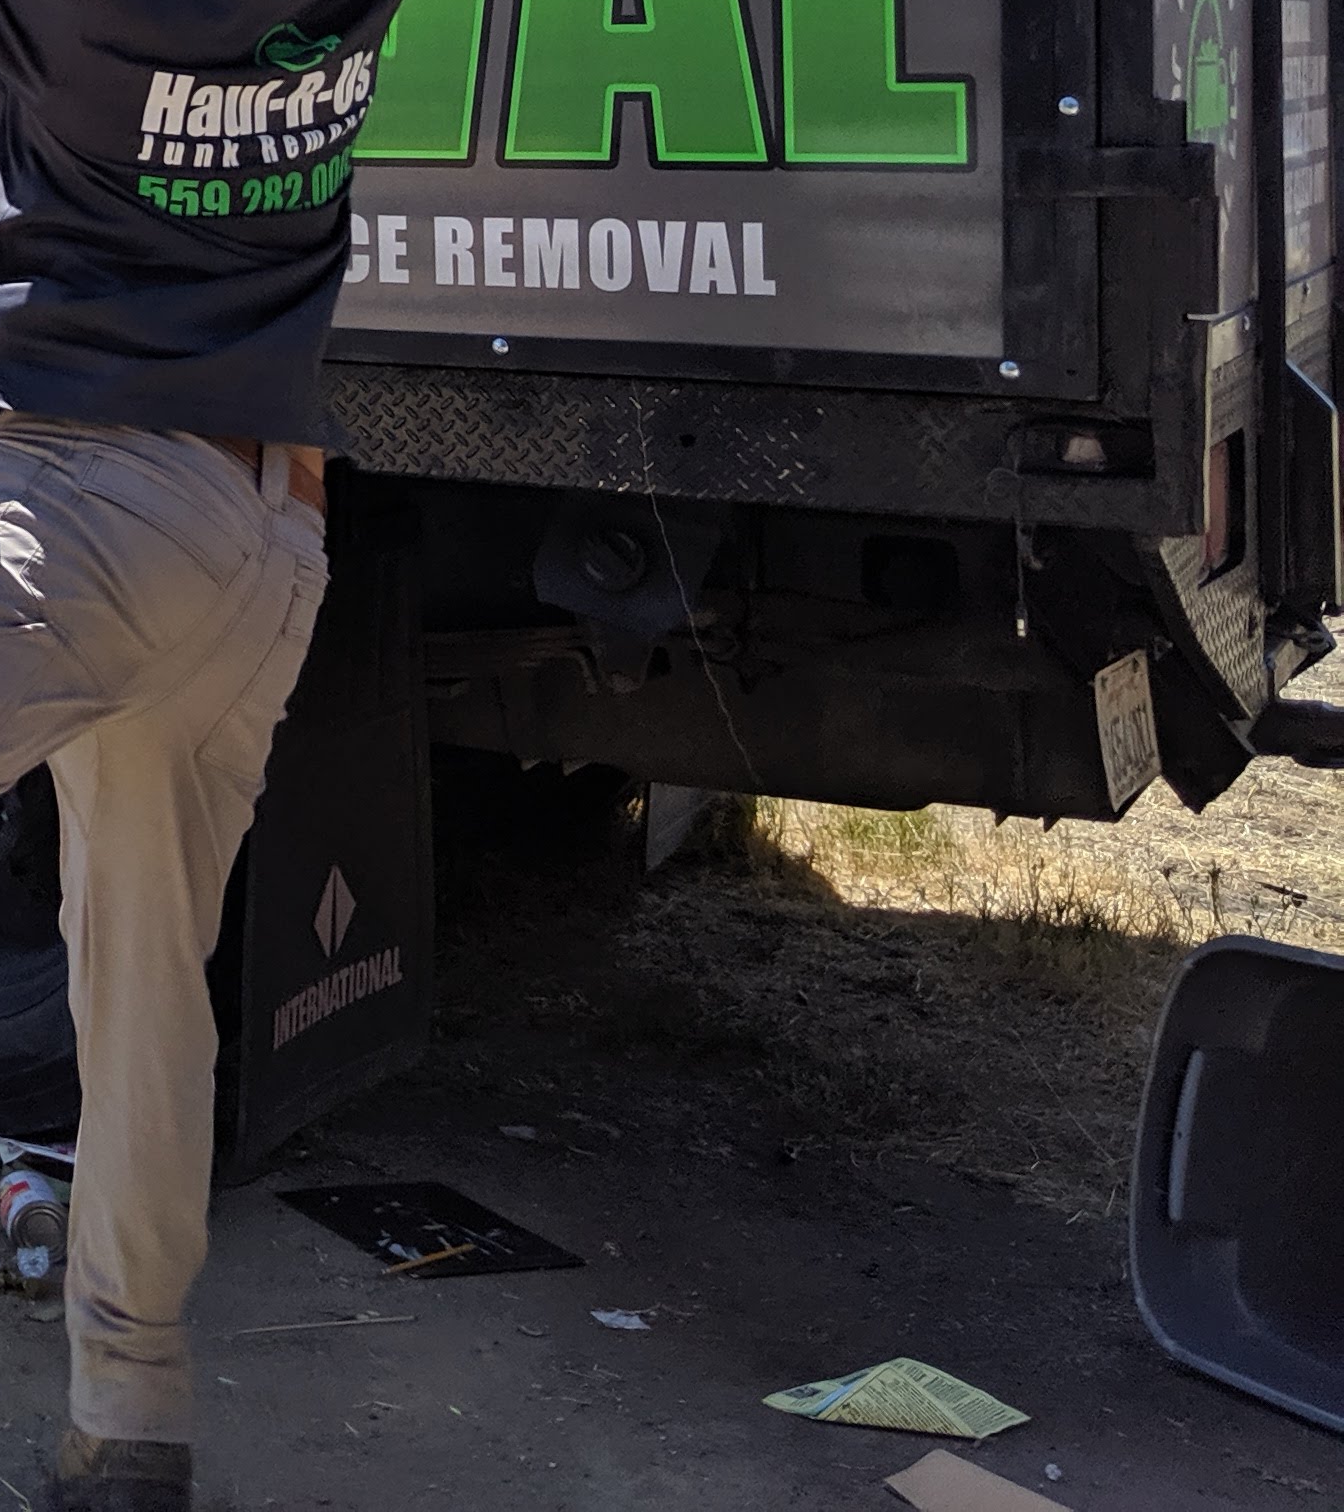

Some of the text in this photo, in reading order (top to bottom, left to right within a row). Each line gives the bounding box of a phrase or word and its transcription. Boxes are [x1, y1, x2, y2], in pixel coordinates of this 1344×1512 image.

[137, 134, 240, 168] Junk
[138, 175, 230, 217] 559
[434, 218, 776, 296] REMOVAL
[273, 945, 403, 1051] INTERNATIONAL
